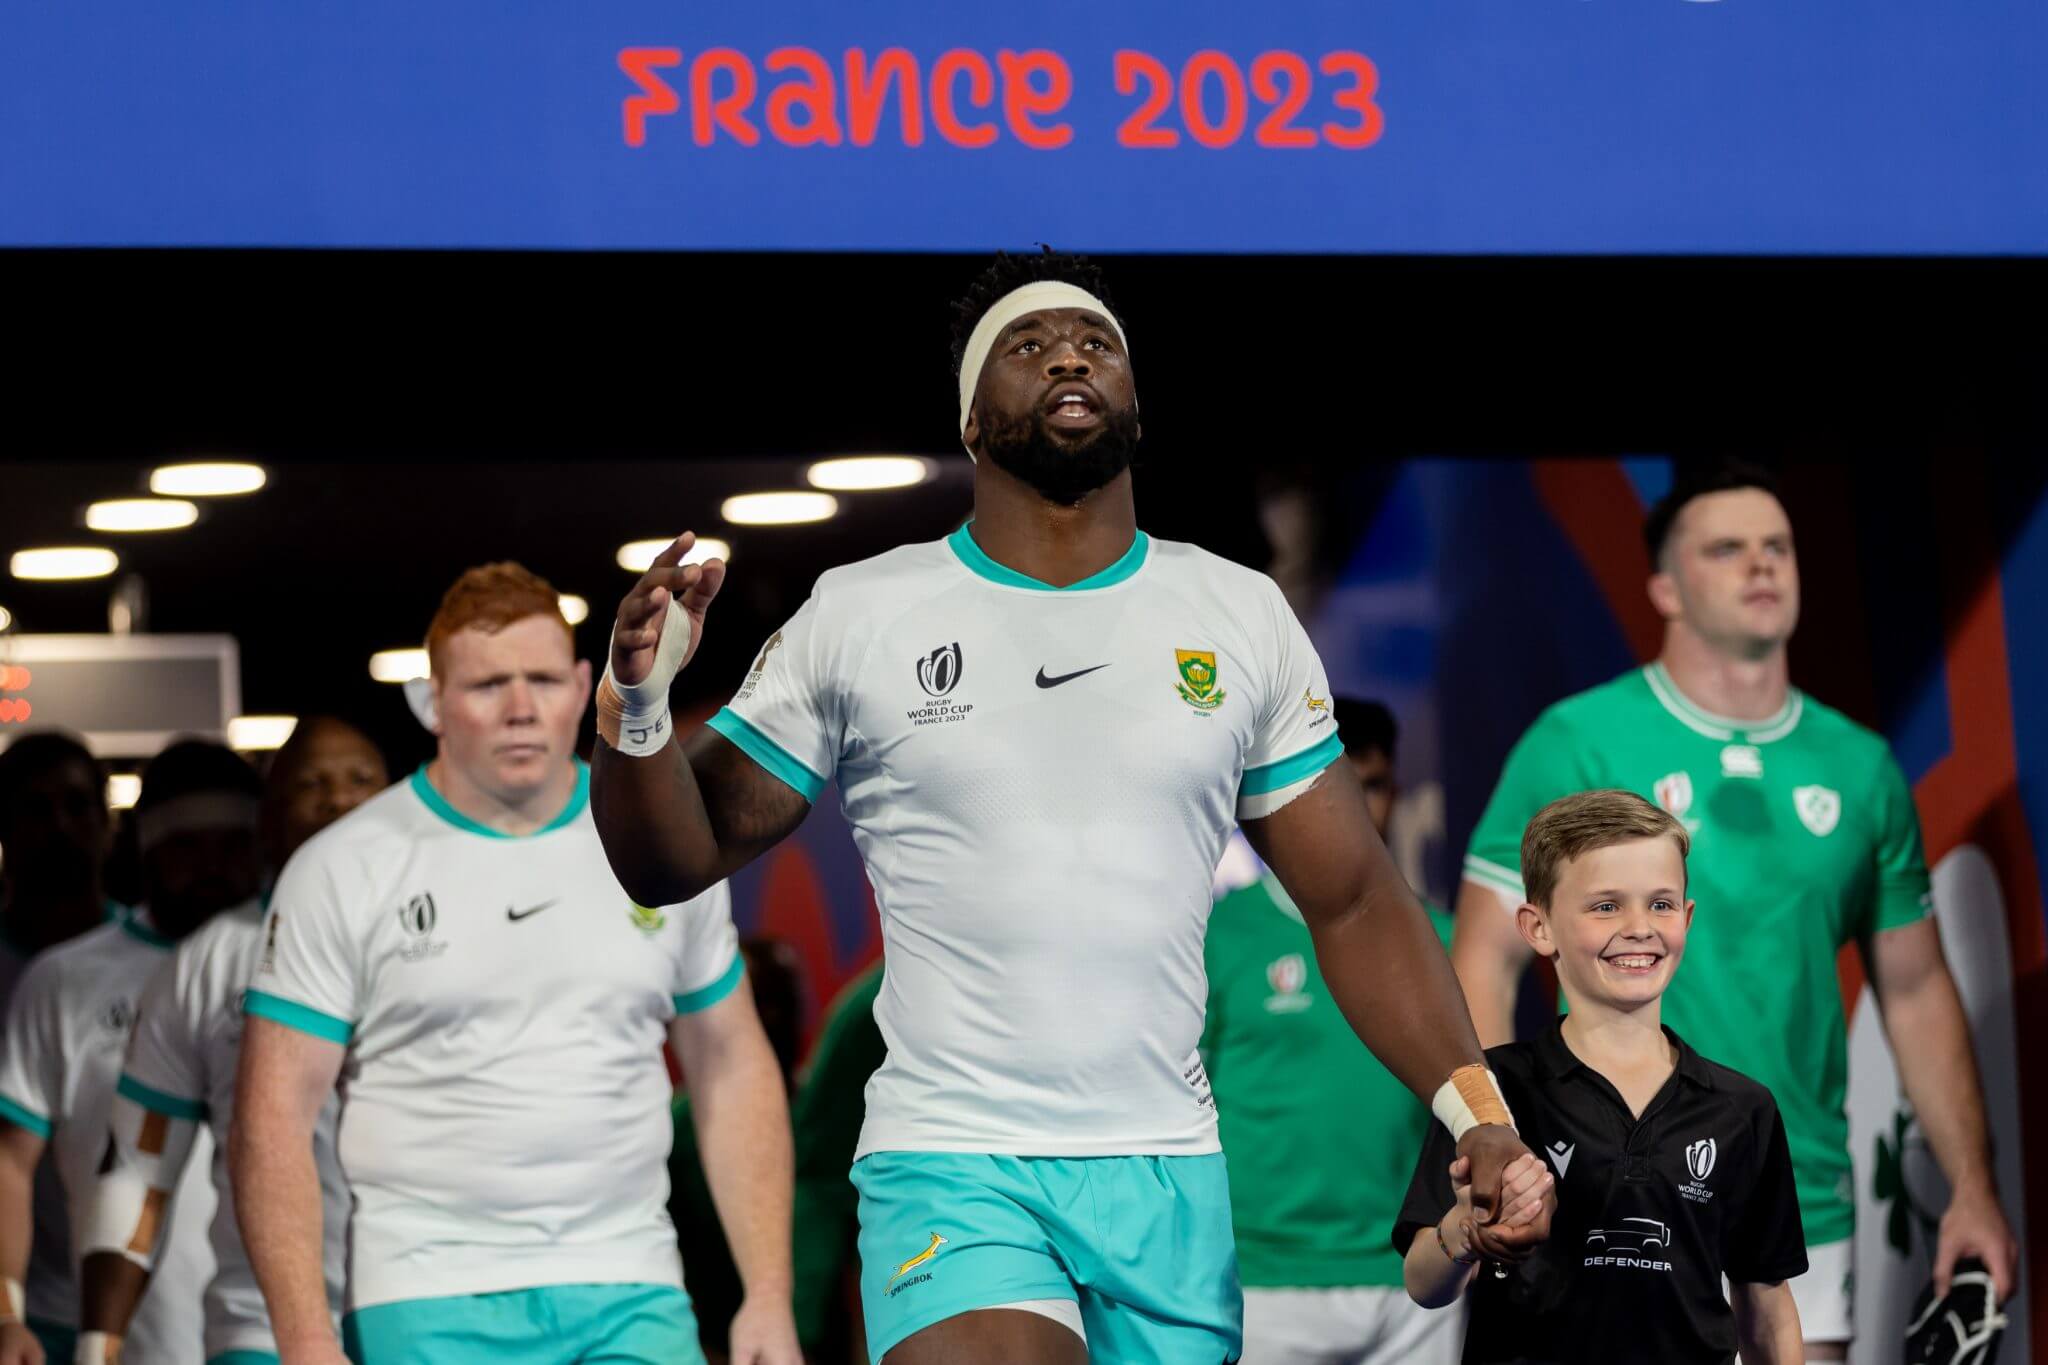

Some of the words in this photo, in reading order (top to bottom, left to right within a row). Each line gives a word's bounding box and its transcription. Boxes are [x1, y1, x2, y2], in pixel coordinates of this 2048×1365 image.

[1116, 50, 1385, 149] 2023
[926, 699, 952, 707] RUGBY
[907, 706, 948, 719] WORLD
[951, 704, 973, 714] CUP
[914, 717, 943, 726] FRANCE
[945, 714, 966, 723] 2023
[1678, 1184, 1702, 1196] WORLD
[1702, 1190, 1714, 1198] CUP
[1584, 1257, 1672, 1271] DEFENDER
[890, 1272, 933, 1298] SPRINGBOK
